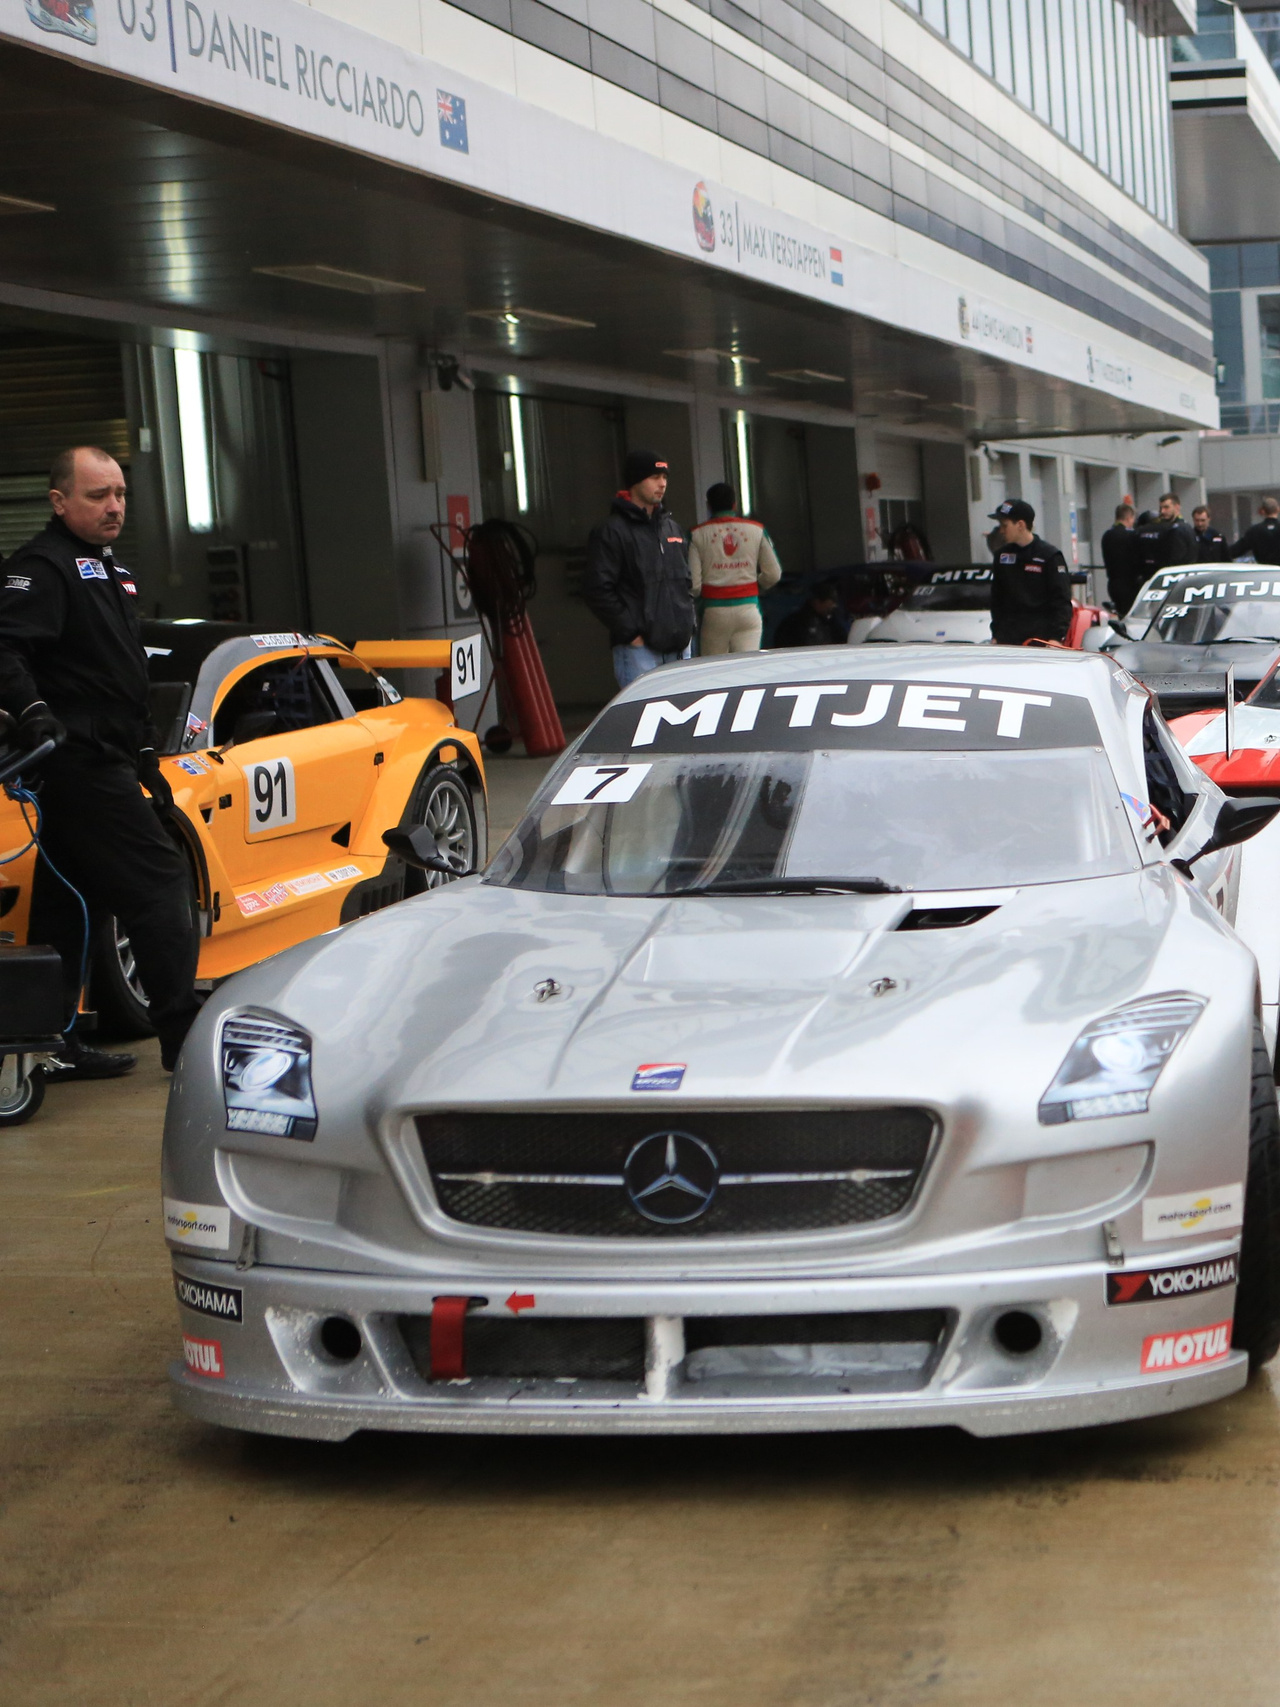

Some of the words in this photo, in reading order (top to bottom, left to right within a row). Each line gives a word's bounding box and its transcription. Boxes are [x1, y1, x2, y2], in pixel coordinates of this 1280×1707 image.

[185, 0, 290, 91] DANIEL
[295, 43, 425, 137] RICCIARDO
[720, 209, 734, 247] 33
[743, 220, 768, 260] MAX
[768, 229, 827, 278] VERSTAPPEN
[931, 568, 994, 584] MITJ
[1162, 605, 1190, 619] 24
[456, 643, 476, 685] 91
[631, 684, 1052, 748] MITJET
[254, 761, 288, 823] 91
[582, 767, 630, 801] 7
[1157, 1202, 1232, 1224] motorsport.com
[1149, 1258, 1236, 1296] YOKOHAMA
[178, 1279, 238, 1316] OKOHAMA
[1146, 1325, 1229, 1368] MOTUL
